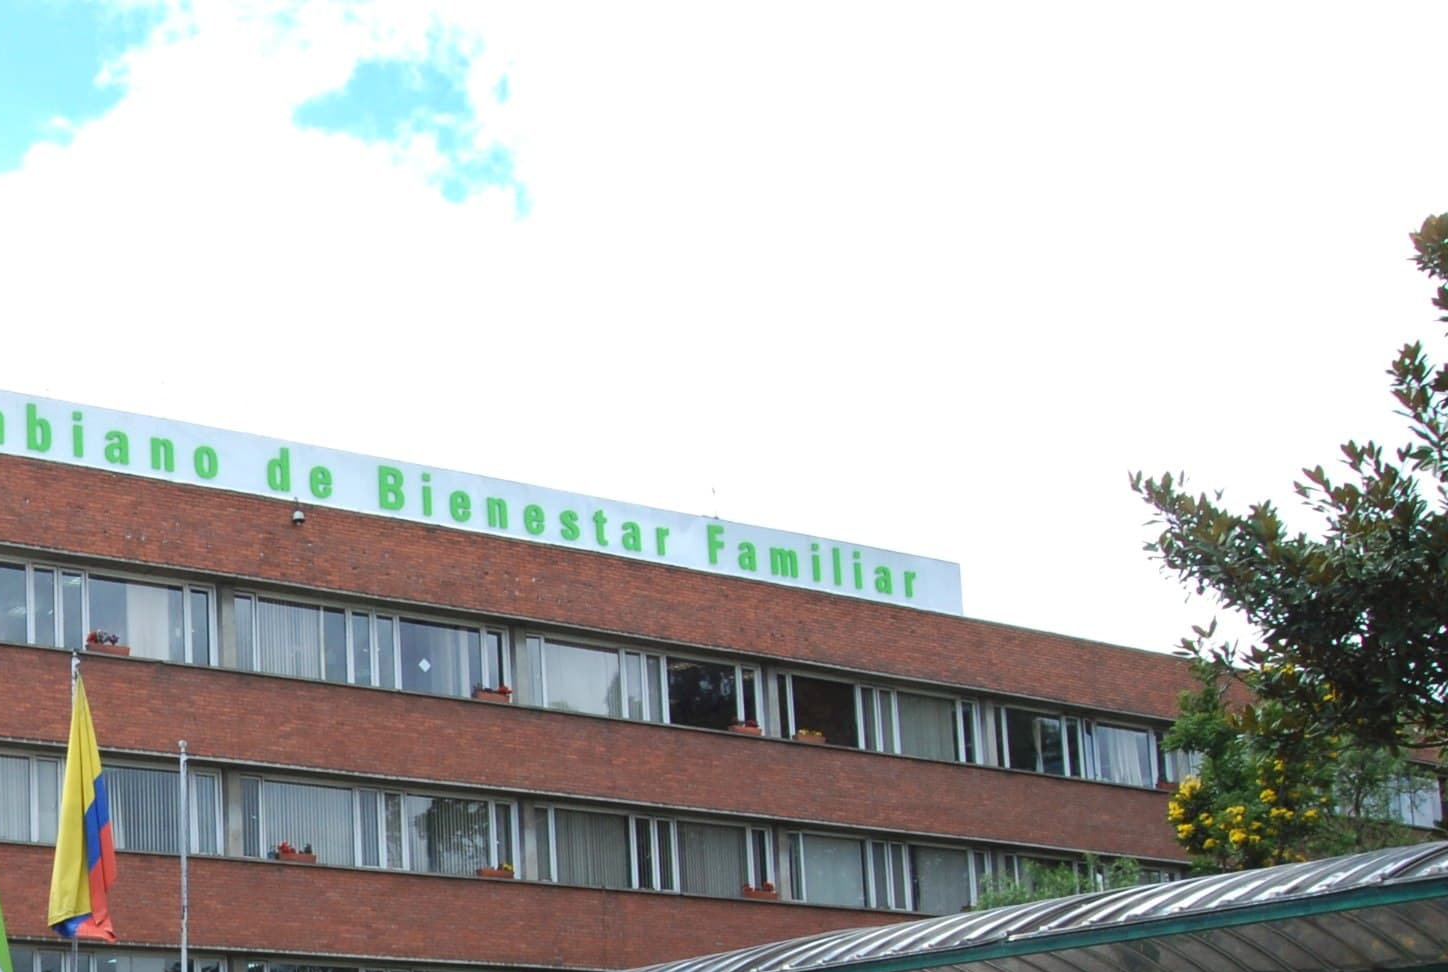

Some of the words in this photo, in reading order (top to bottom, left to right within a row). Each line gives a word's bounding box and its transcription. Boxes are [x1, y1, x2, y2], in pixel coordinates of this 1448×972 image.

[266, 446, 334, 499] de
[378, 465, 670, 557] Bienestar
[706, 523, 918, 600] Familiar
